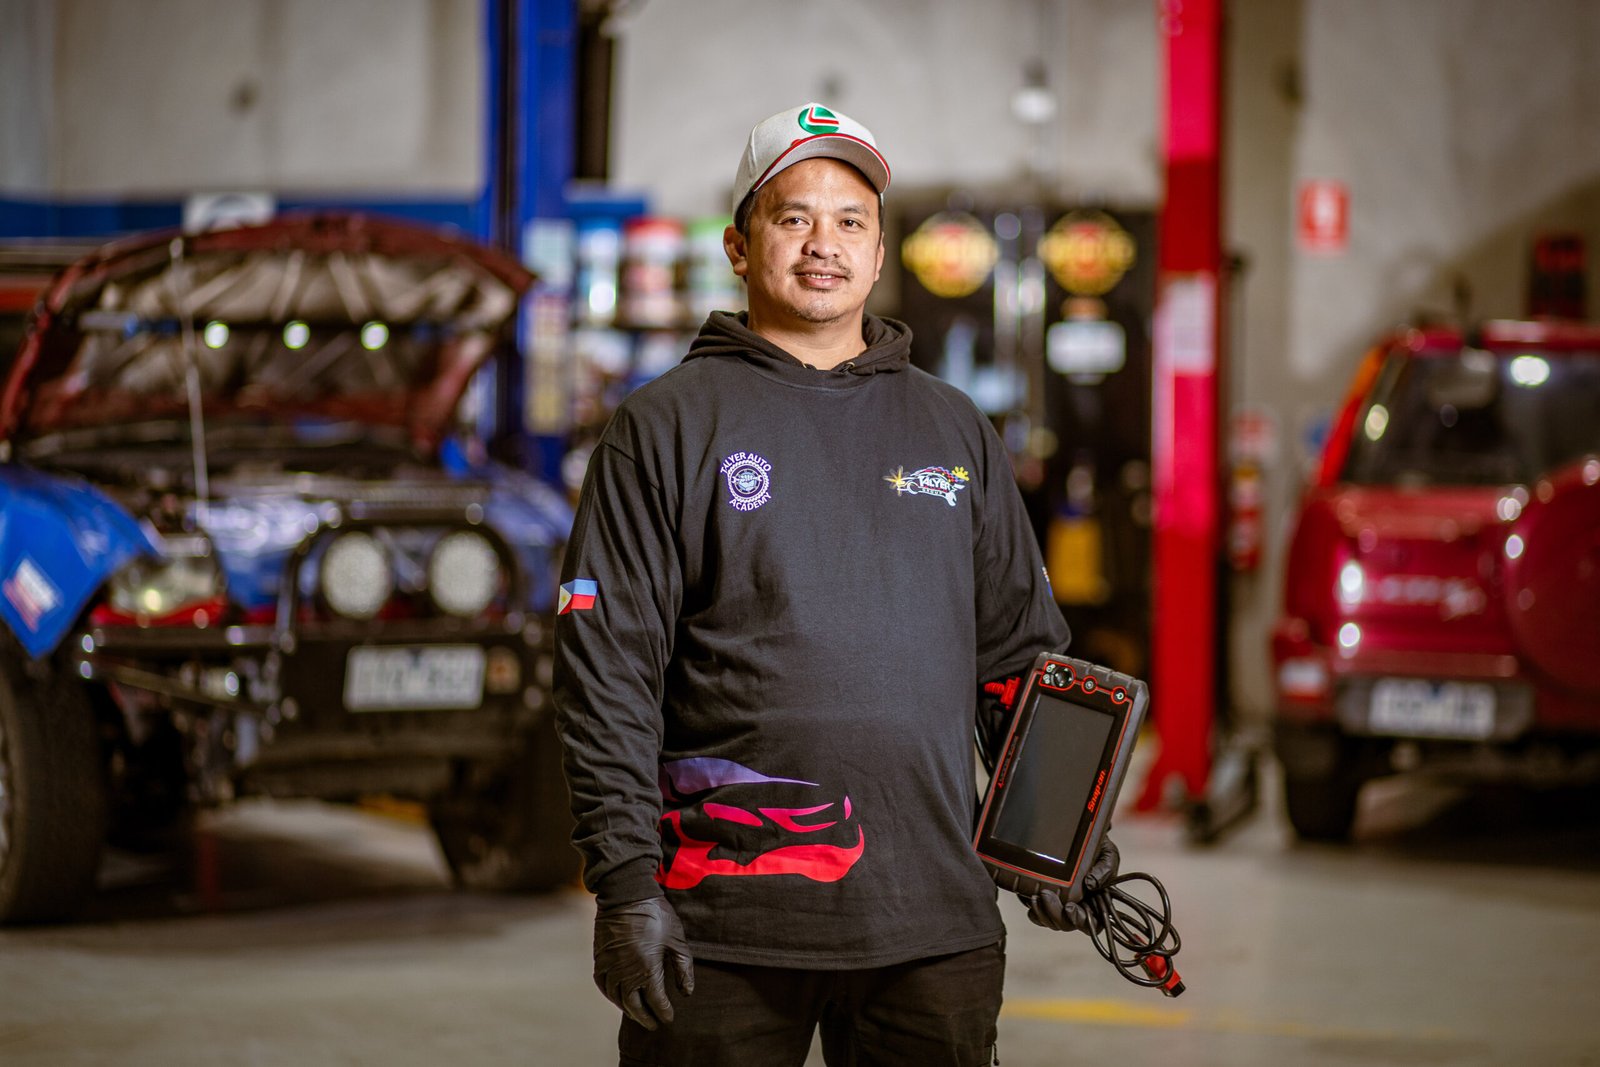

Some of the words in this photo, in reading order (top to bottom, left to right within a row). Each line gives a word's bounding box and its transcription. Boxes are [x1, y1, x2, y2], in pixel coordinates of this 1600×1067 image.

[720, 452, 747, 474] TALYER
[747, 453, 772, 472] AUTO
[917, 475, 951, 491] TALYER
[729, 492, 772, 511] ACADEMY
